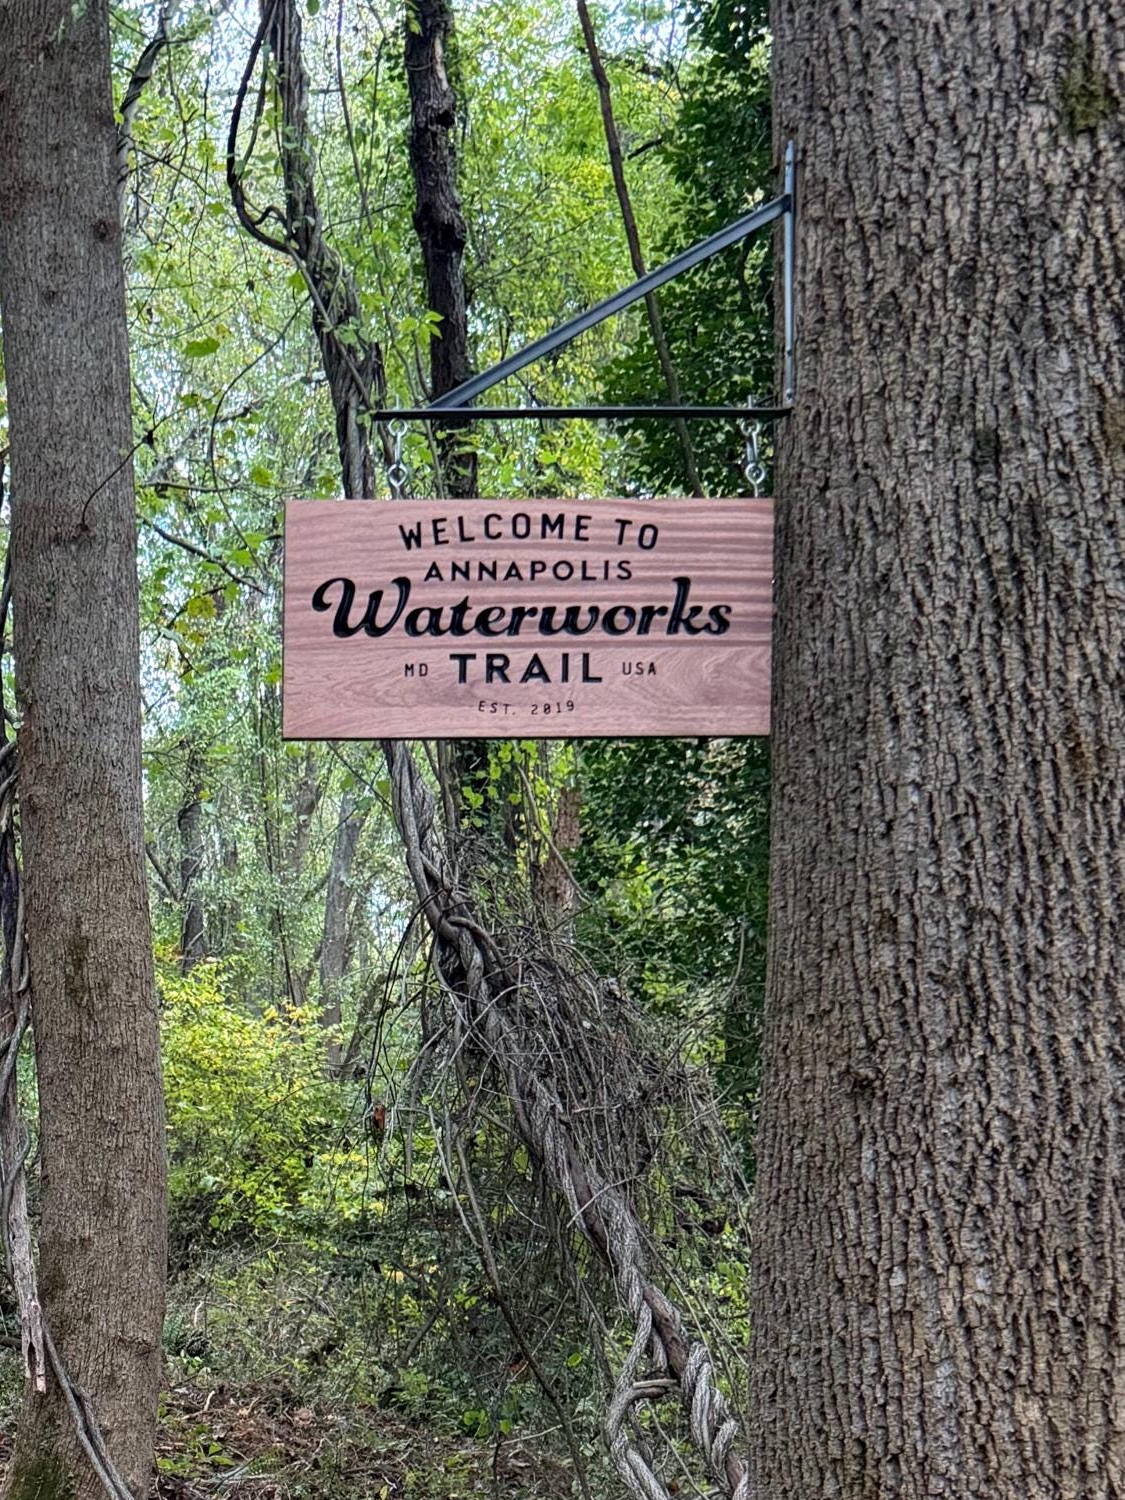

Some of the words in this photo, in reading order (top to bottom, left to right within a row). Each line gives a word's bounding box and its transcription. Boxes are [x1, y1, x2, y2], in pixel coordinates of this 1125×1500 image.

[398, 512, 593, 551] WELCOME
[614, 518, 660, 551] TO
[423, 559, 633, 582] ANNAPOLIS
[311, 576, 733, 639] Waterworks
[403, 662, 429, 677] MD
[449, 652, 603, 684] TRAIL
[621, 661, 657, 676] USA
[477, 699, 517, 716] EST.
[530, 699, 575, 716] 2019
